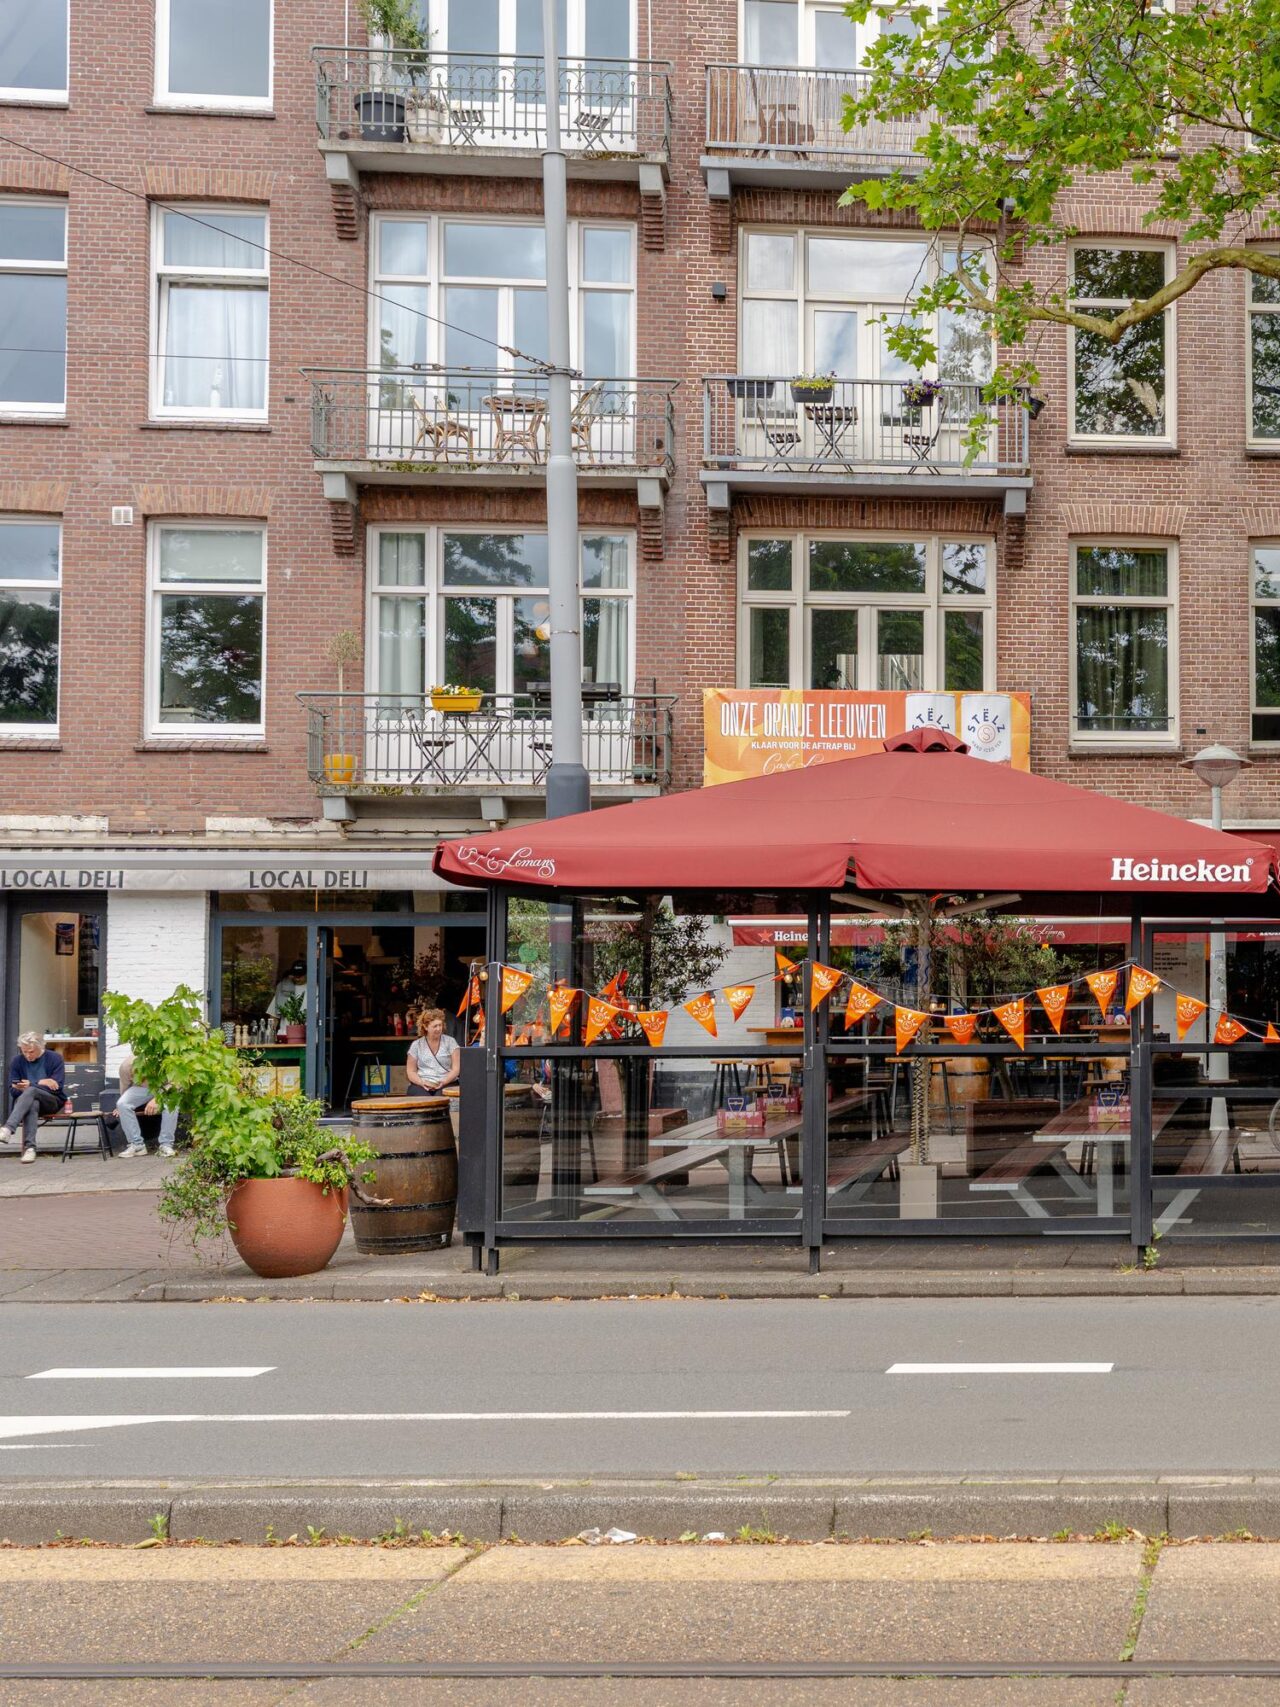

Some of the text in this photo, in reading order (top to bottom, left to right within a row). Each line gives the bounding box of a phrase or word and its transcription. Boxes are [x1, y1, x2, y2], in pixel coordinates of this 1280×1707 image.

[721, 702, 886, 738] ONZE ORANJE LEEUWEN
[968, 708, 1005, 733] STËLZ
[751, 742, 857, 751] KLAAR VOOR DE AFTRAP BIJ
[497, 847, 556, 878] Lomans
[1, 870, 125, 889] LOCAL DELI
[249, 870, 369, 889] LOCAL DELI
